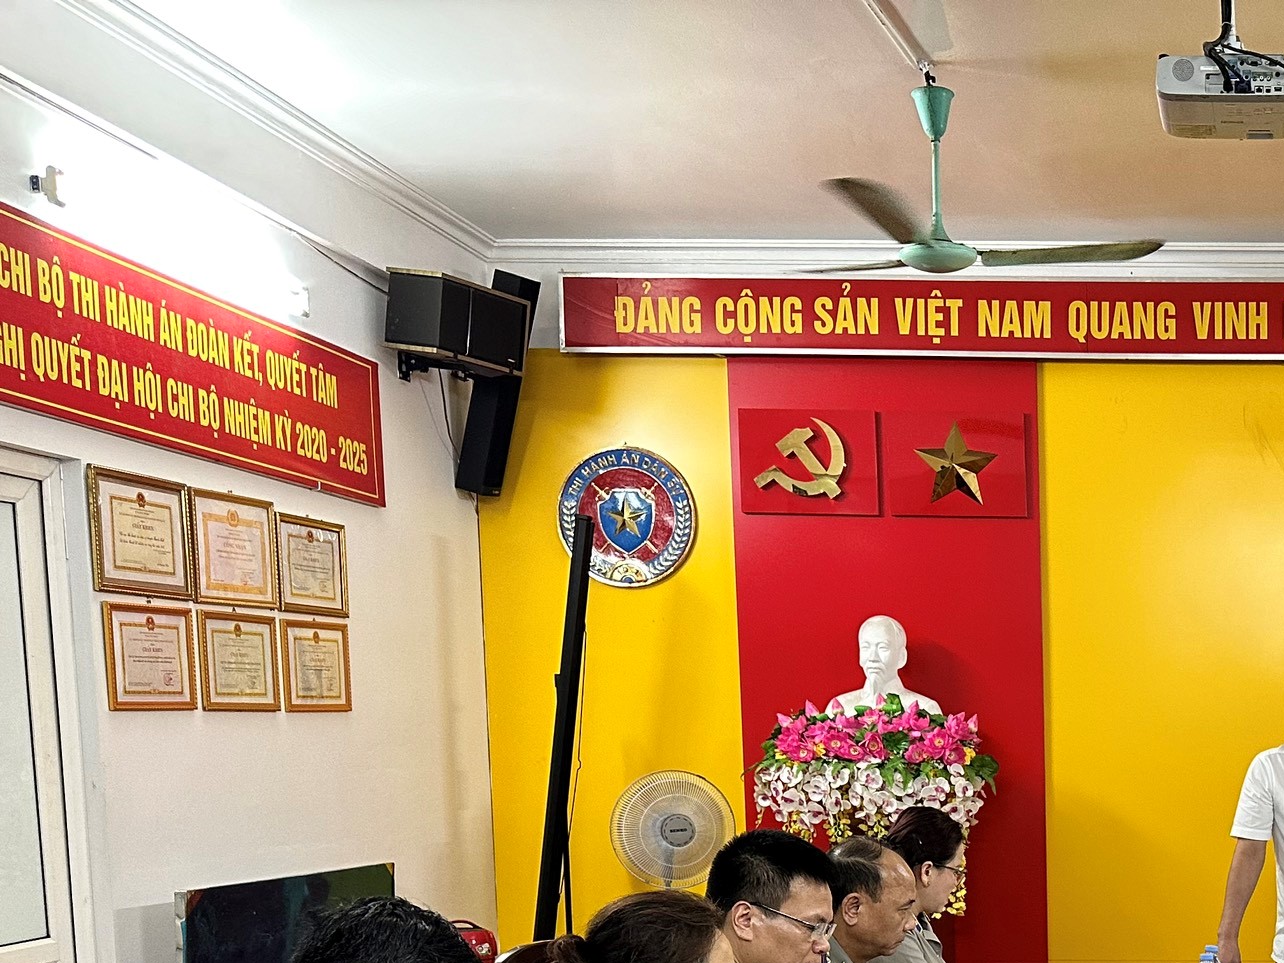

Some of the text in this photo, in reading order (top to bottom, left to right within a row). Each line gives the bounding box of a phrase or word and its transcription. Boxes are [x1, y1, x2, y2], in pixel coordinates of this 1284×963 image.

[0, 242, 338, 409] CHI BỘ THI HÀNH ÁN ĐOÀN KẾT, QUYẾT TÂM
[614, 281, 702, 334] ĐẢNG
[715, 289, 803, 342] CỘNG
[813, 282, 879, 335] SẢN
[895, 289, 963, 344] VIỆT
[977, 299, 1051, 339] NAM
[1067, 300, 1176, 343] QUANG
[1193, 301, 1268, 340] VINH
[31, 333, 91, 391] QUYẾT
[97, 354, 129, 409] ĐẠI
[133, 362, 163, 420] HỘI
[167, 377, 195, 423] CHI
[198, 384, 220, 439] BỘ
[224, 398, 272, 450] NHIỆM
[275, 410, 292, 452] KỲ
[296, 421, 328, 463] 2020
[331, 448, 336, 456] -
[338, 435, 368, 475] 2025
[568, 477, 582, 496] THI
[581, 454, 617, 477] HÀNH
